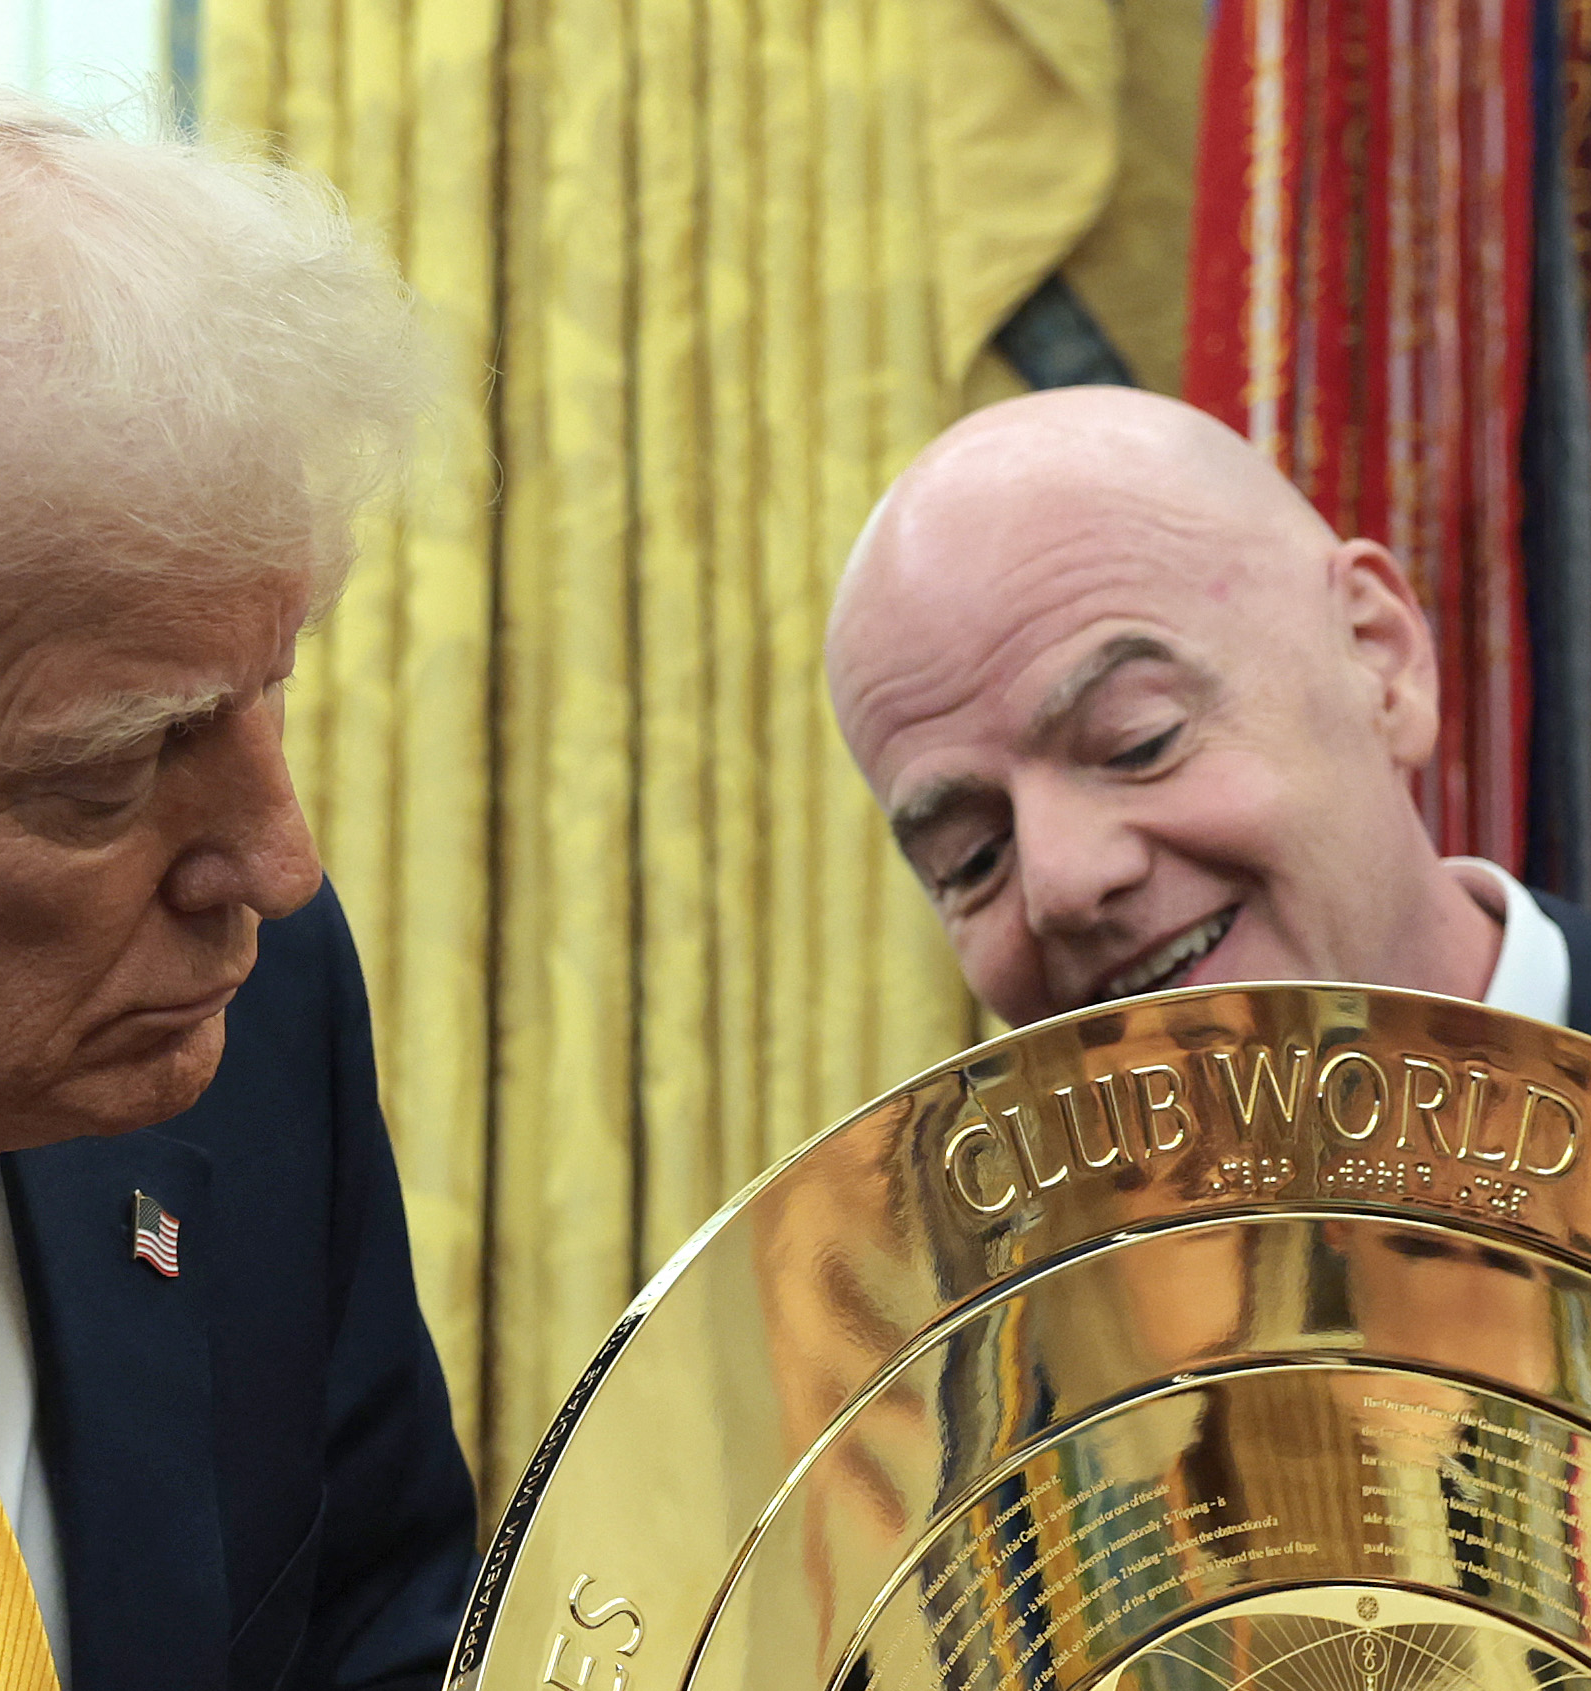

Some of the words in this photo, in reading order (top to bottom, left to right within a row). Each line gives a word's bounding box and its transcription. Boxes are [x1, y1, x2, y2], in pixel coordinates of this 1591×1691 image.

[943, 1062, 1192, 1216] CLUB
[1211, 1047, 1582, 1178] WORLD
[992, 1499, 1024, 1530] choose
[1018, 1518, 1045, 1545] Catch
[1037, 1662, 1056, 1683] the
